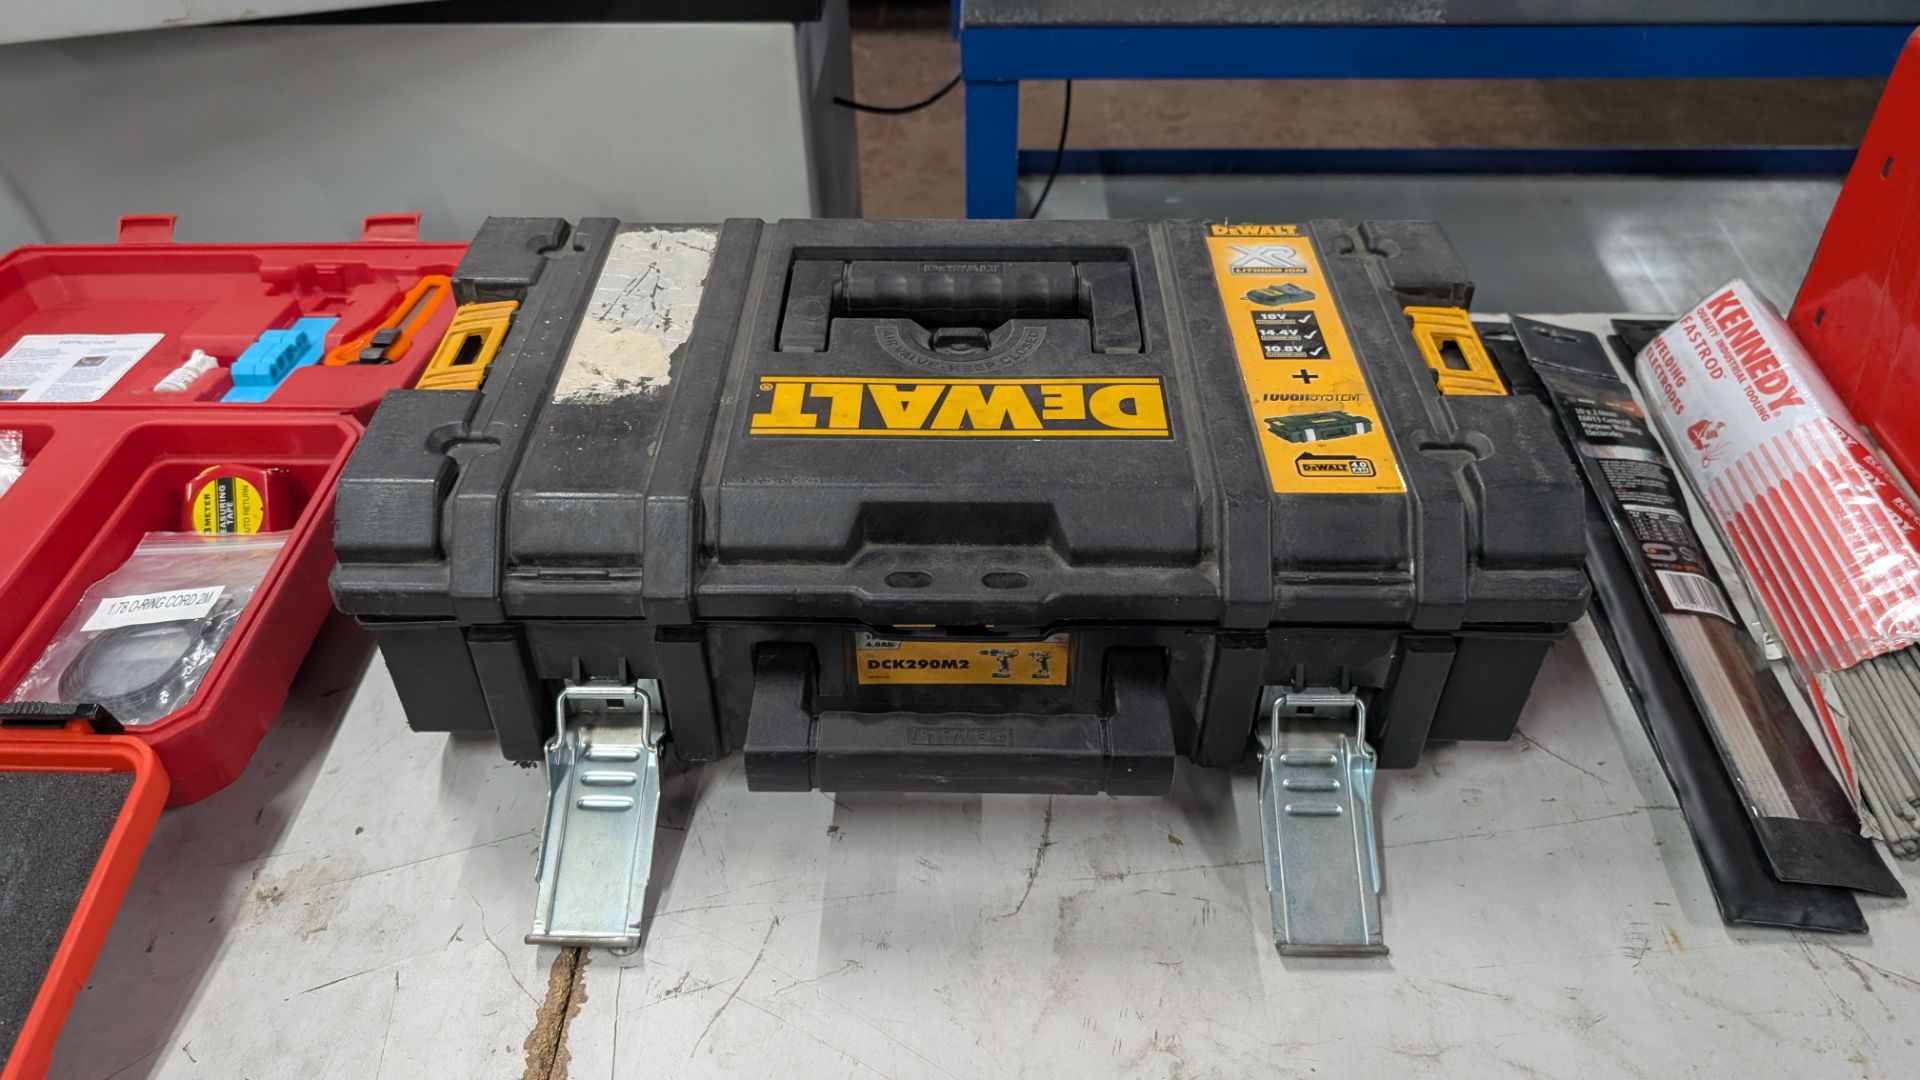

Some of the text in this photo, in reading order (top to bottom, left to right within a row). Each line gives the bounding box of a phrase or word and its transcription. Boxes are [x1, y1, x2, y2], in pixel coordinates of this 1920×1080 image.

[1228, 244, 1307, 267] XR
[1001, 330, 1040, 365] CLOSED
[1653, 335, 1686, 388] WELDING
[1680, 315, 1724, 379] FASTROD
[1696, 307, 1770, 422] QUALITY INDUSTRIAL TOOLING
[1706, 289, 1805, 411] KENNEDY
[1646, 347, 1684, 415] ELECTRODES
[750, 383, 1168, 430] DEWALT
[1302, 464, 1348, 472] DEWALT
[218, 485, 227, 534] EASURING
[226, 501, 234, 525] TAPE
[242, 485, 250, 516] RETURN
[107, 591, 215, 615] 1.78 O-RING CORD 2M
[867, 659, 970, 669] DCK290M2
